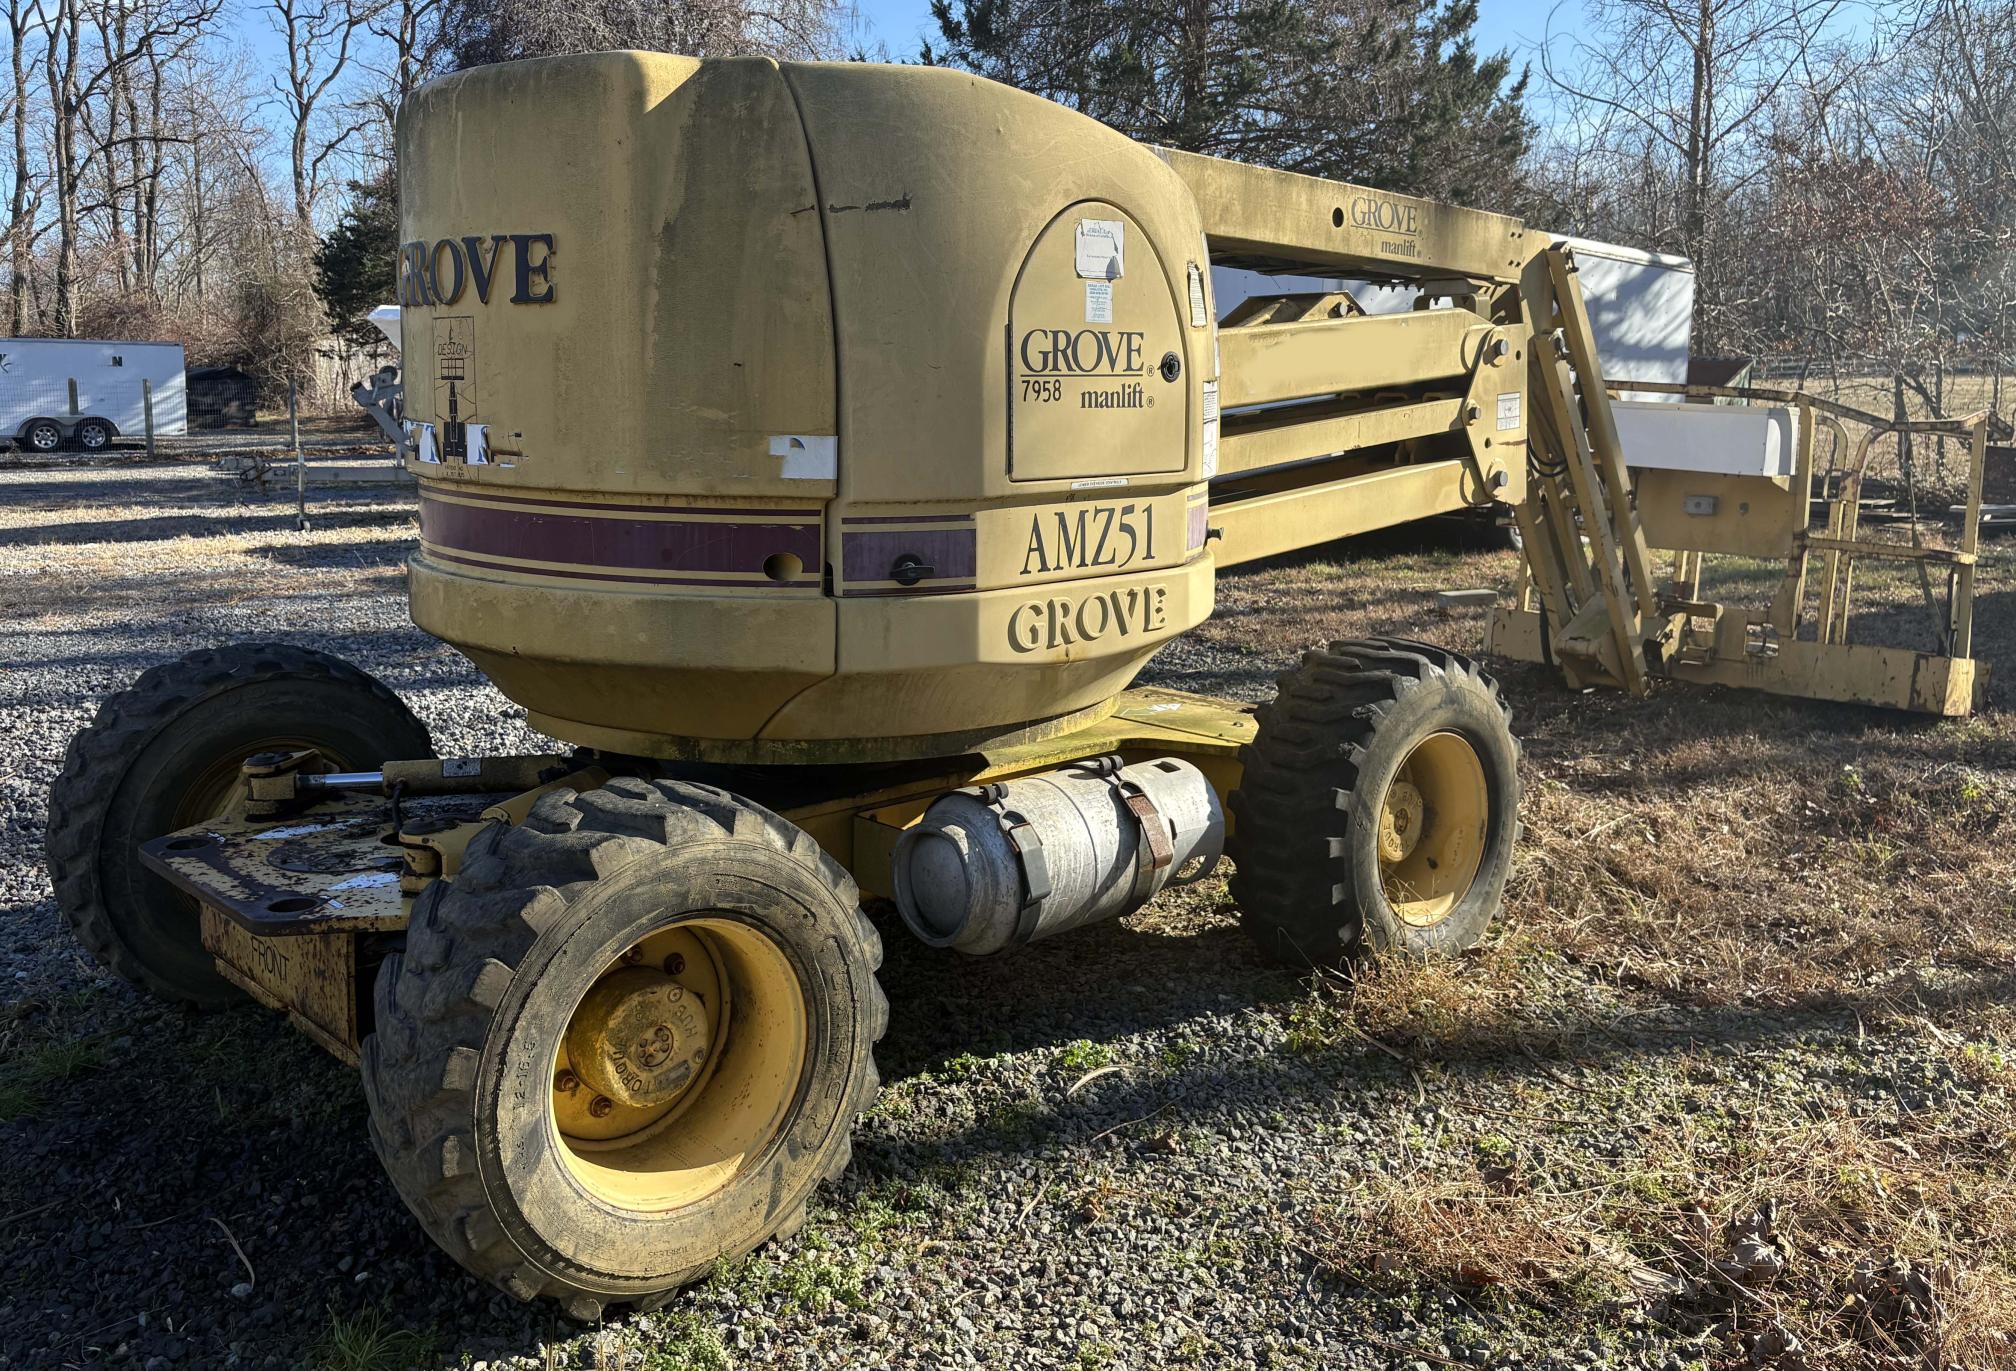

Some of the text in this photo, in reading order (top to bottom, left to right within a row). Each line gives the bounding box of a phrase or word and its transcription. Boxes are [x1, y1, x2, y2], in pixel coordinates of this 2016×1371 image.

[1351, 197, 1418, 233] GROVE
[1381, 240, 1416, 257] manlift
[1020, 329, 1144, 373] GROVE
[1021, 379, 1062, 403] 7958
[1080, 382, 1145, 408] manlift
[1019, 503, 1156, 575] AMZ51
[1007, 584, 1168, 653] GROVE
[251, 936, 290, 984] FRONT
[674, 1004, 698, 1039] HUB
